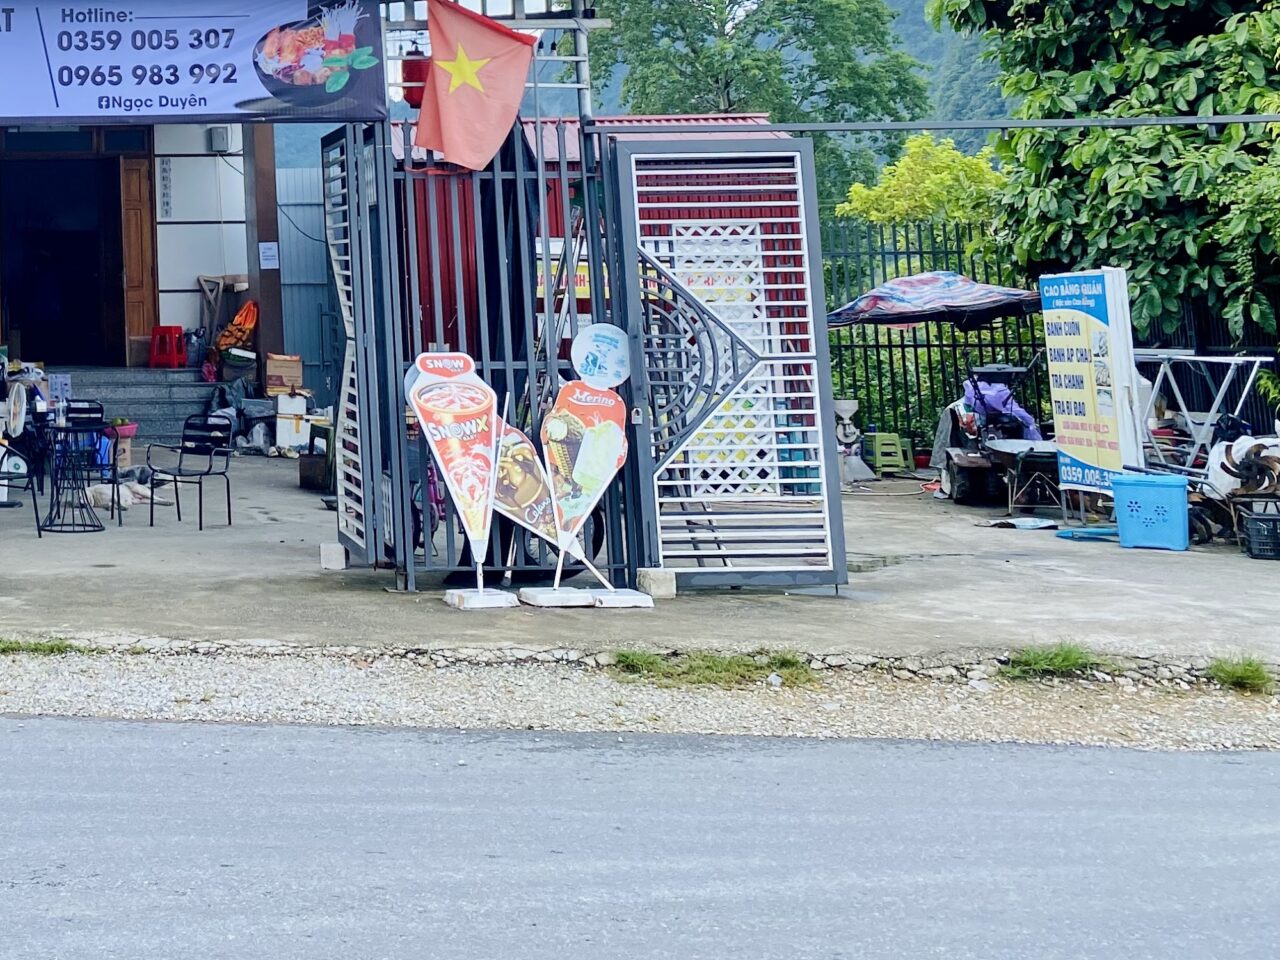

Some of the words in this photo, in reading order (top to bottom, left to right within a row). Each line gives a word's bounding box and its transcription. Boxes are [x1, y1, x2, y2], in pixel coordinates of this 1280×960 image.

[61, 8, 134, 23] Hotline:
[57, 30, 122, 51] 0359
[131, 29, 179, 50] 005
[188, 28, 235, 50] 307
[57, 65, 123, 86] 0965
[131, 64, 180, 85] 983
[189, 63, 238, 84] 992
[112, 96, 153, 112] Ngọc
[159, 94, 207, 110] Duyên
[1043, 285, 1059, 297] CAO
[426, 359, 465, 369] SNOW
[573, 388, 616, 406] Merino
